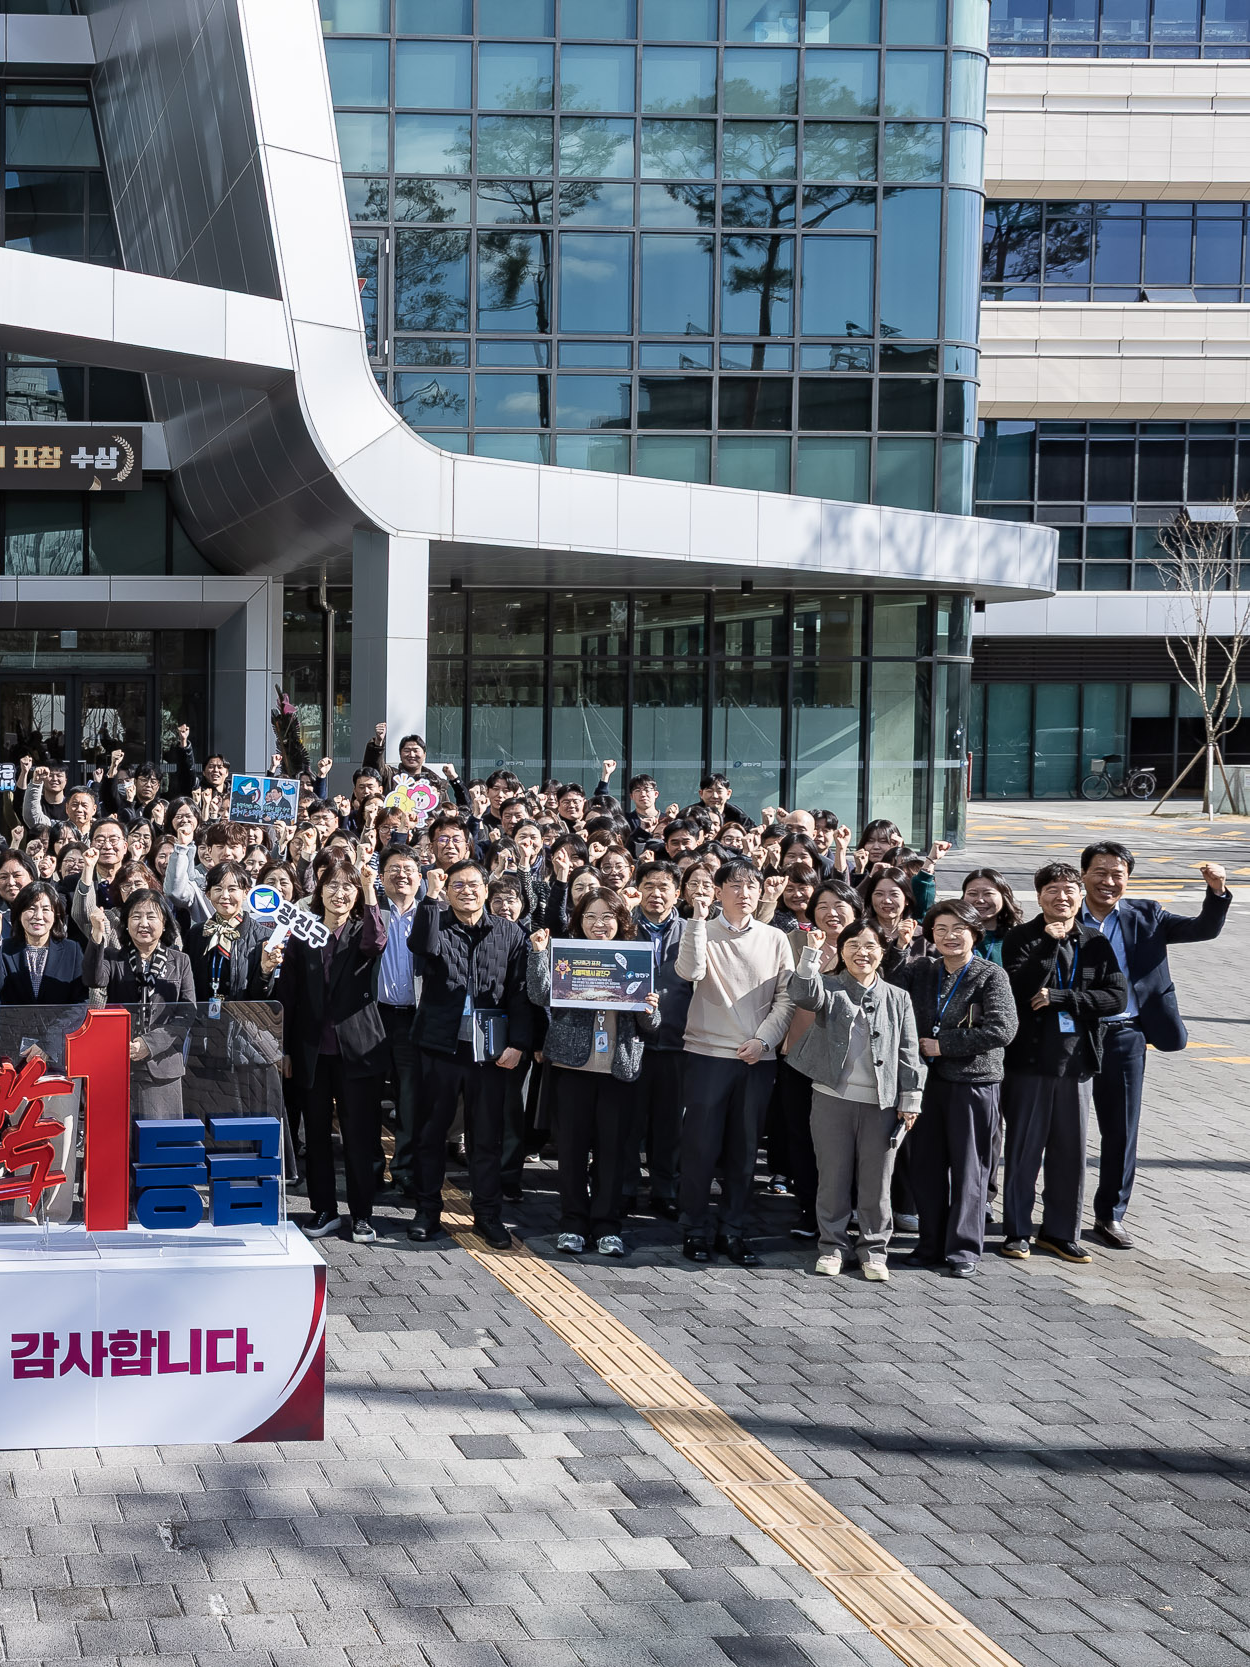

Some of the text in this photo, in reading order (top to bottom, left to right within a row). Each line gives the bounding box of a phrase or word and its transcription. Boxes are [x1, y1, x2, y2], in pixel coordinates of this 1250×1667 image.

[14, 446, 63, 469] 표창
[70, 446, 120, 470] 수상
[276, 903, 327, 945] 광진구
[11, 1328, 264, 1379] 감사합니다.
